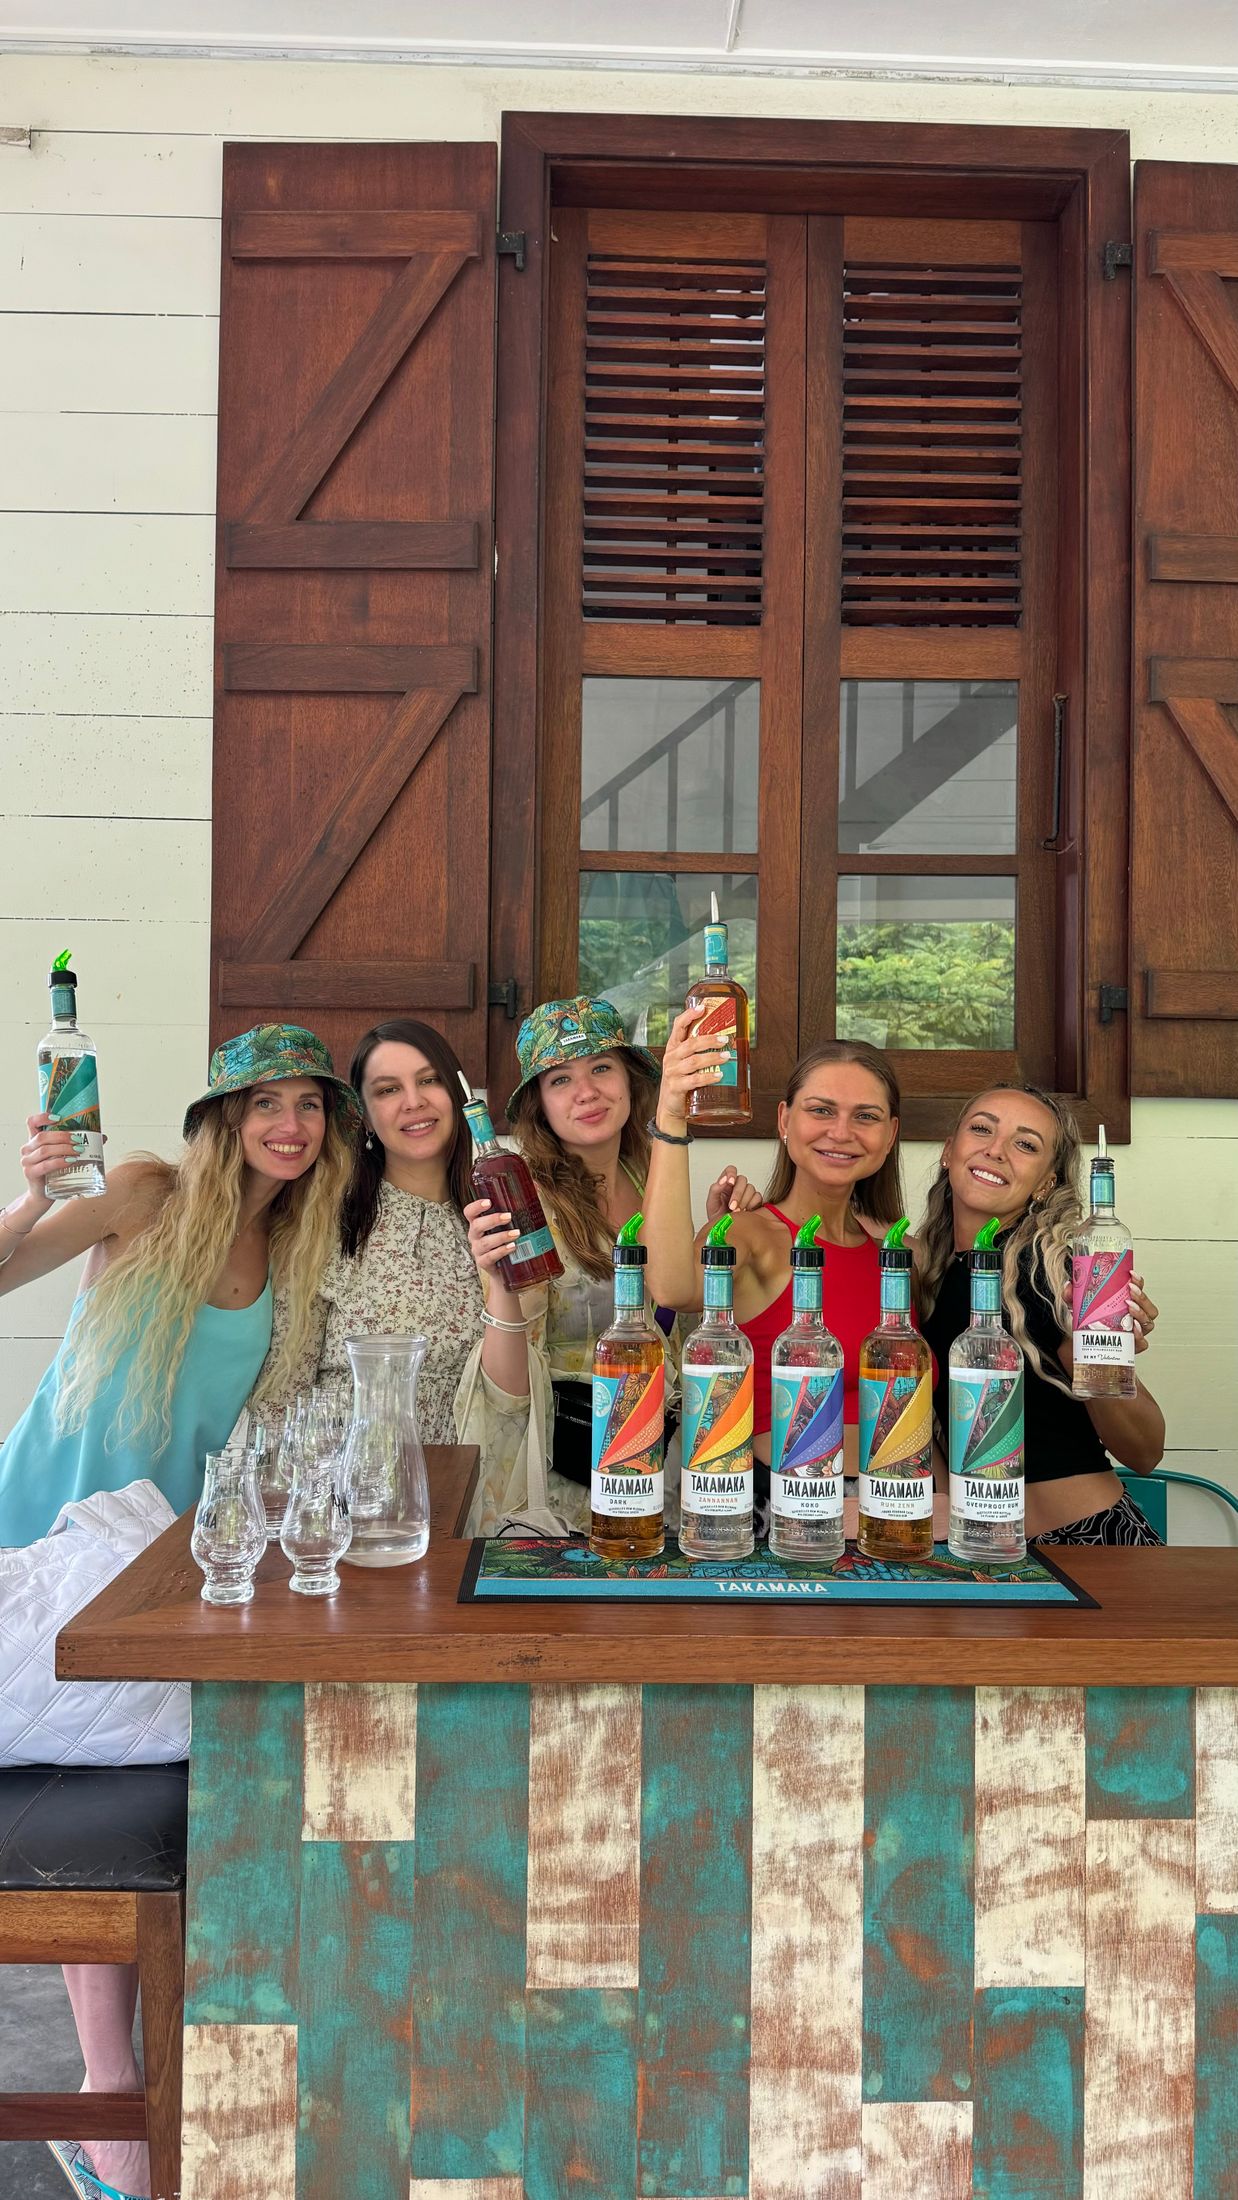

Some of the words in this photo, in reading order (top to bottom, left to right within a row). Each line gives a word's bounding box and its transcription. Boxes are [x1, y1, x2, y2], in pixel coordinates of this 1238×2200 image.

[1081, 1334, 1123, 1348] TAKAMAKA
[600, 1476, 654, 1495] TAKAMAKA
[691, 1474, 745, 1493] TAKAMAKA
[782, 1479, 837, 1498] TAKAMAKA
[869, 1479, 925, 1498] TAKAMAKA
[964, 1480, 1020, 1499] TAKAMAKA
[966, 1501, 1006, 1509] OVERPROOF
[714, 1582, 828, 1592] TAKAMAKA
